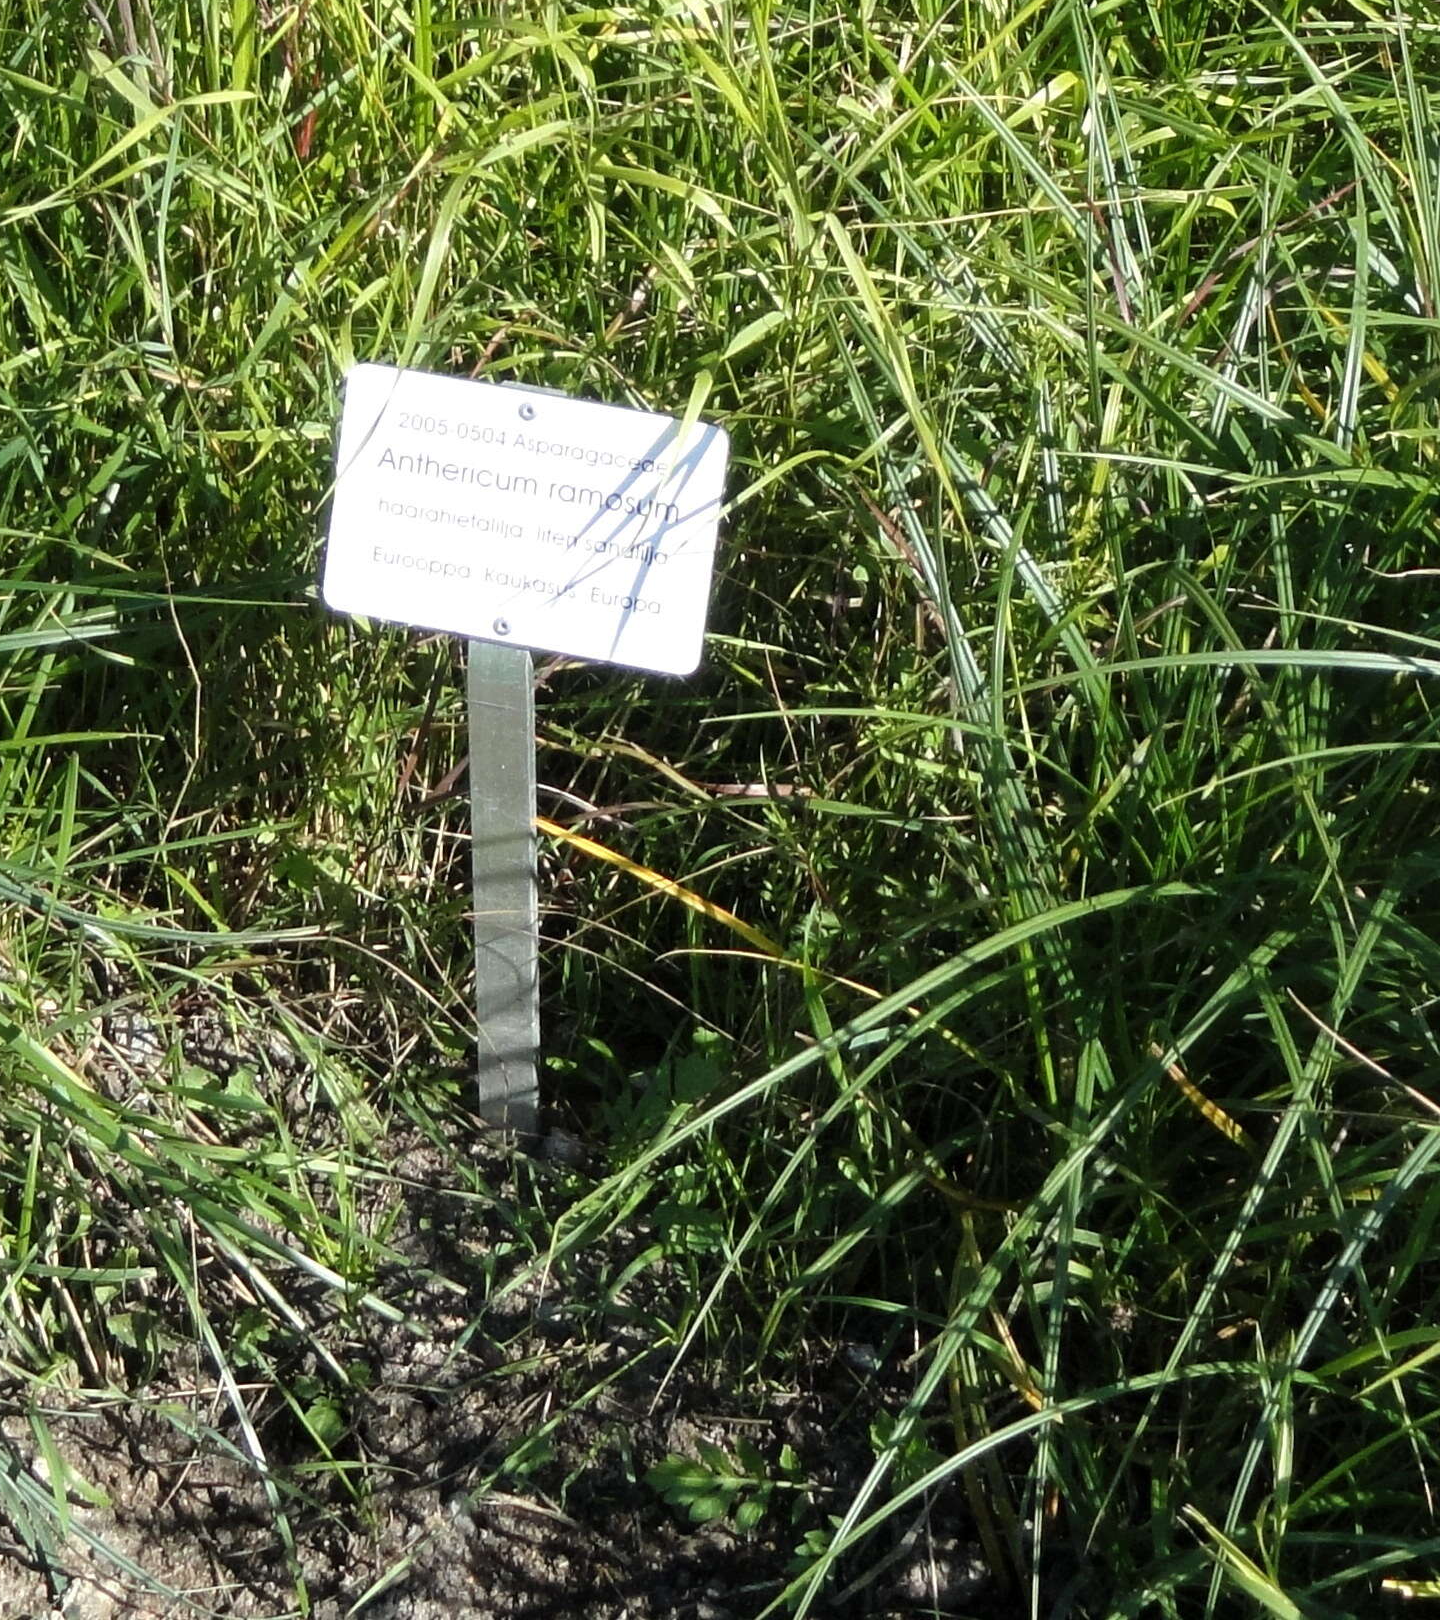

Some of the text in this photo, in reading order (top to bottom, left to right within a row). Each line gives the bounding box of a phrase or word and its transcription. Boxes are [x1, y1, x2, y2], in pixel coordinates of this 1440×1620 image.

[398, 412, 668, 477] 2005-0504 Asparagaceae
[377, 447, 680, 522] Anthericum ramosum
[590, 586, 661, 616] Europa
